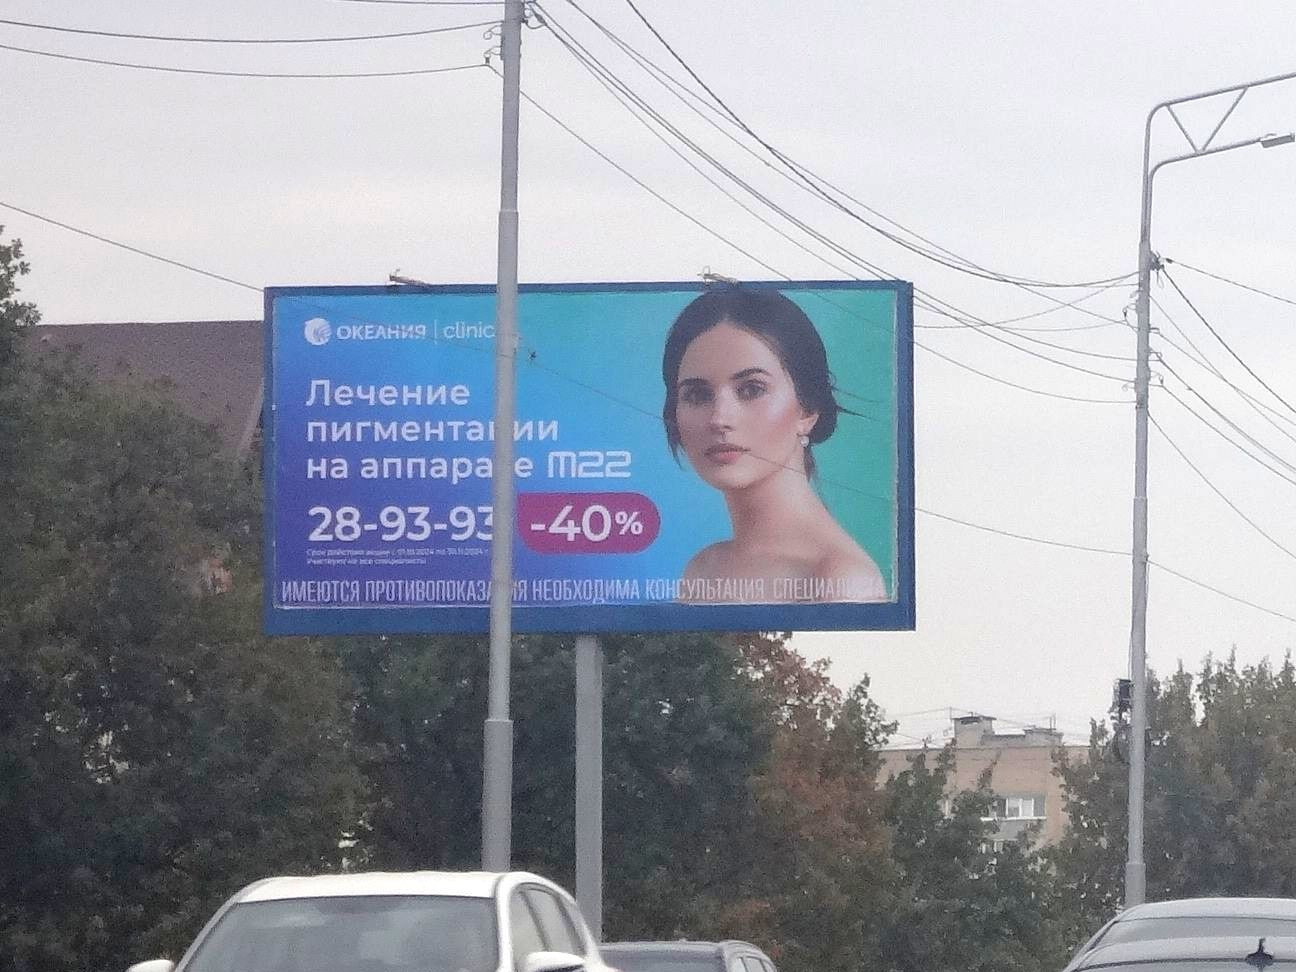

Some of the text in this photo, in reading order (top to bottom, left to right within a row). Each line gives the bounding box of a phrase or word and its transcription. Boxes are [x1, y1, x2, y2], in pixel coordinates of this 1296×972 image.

[336, 320, 496, 341] ОКЕАНИЯ clinic
[305, 379, 471, 407] Лечение
[307, 457, 349, 479] на
[360, 457, 534, 485] аппарае
[308, 505, 495, 542] 28-93-93
[281, 579, 360, 602] ИМЕЮТСЯ
[532, 578, 640, 603] НЕОБХОДИМА
[645, 577, 764, 601] КОНСУЛЬТАЦИЯ
[773, 577, 882, 601] СПЕЦИАЛ
